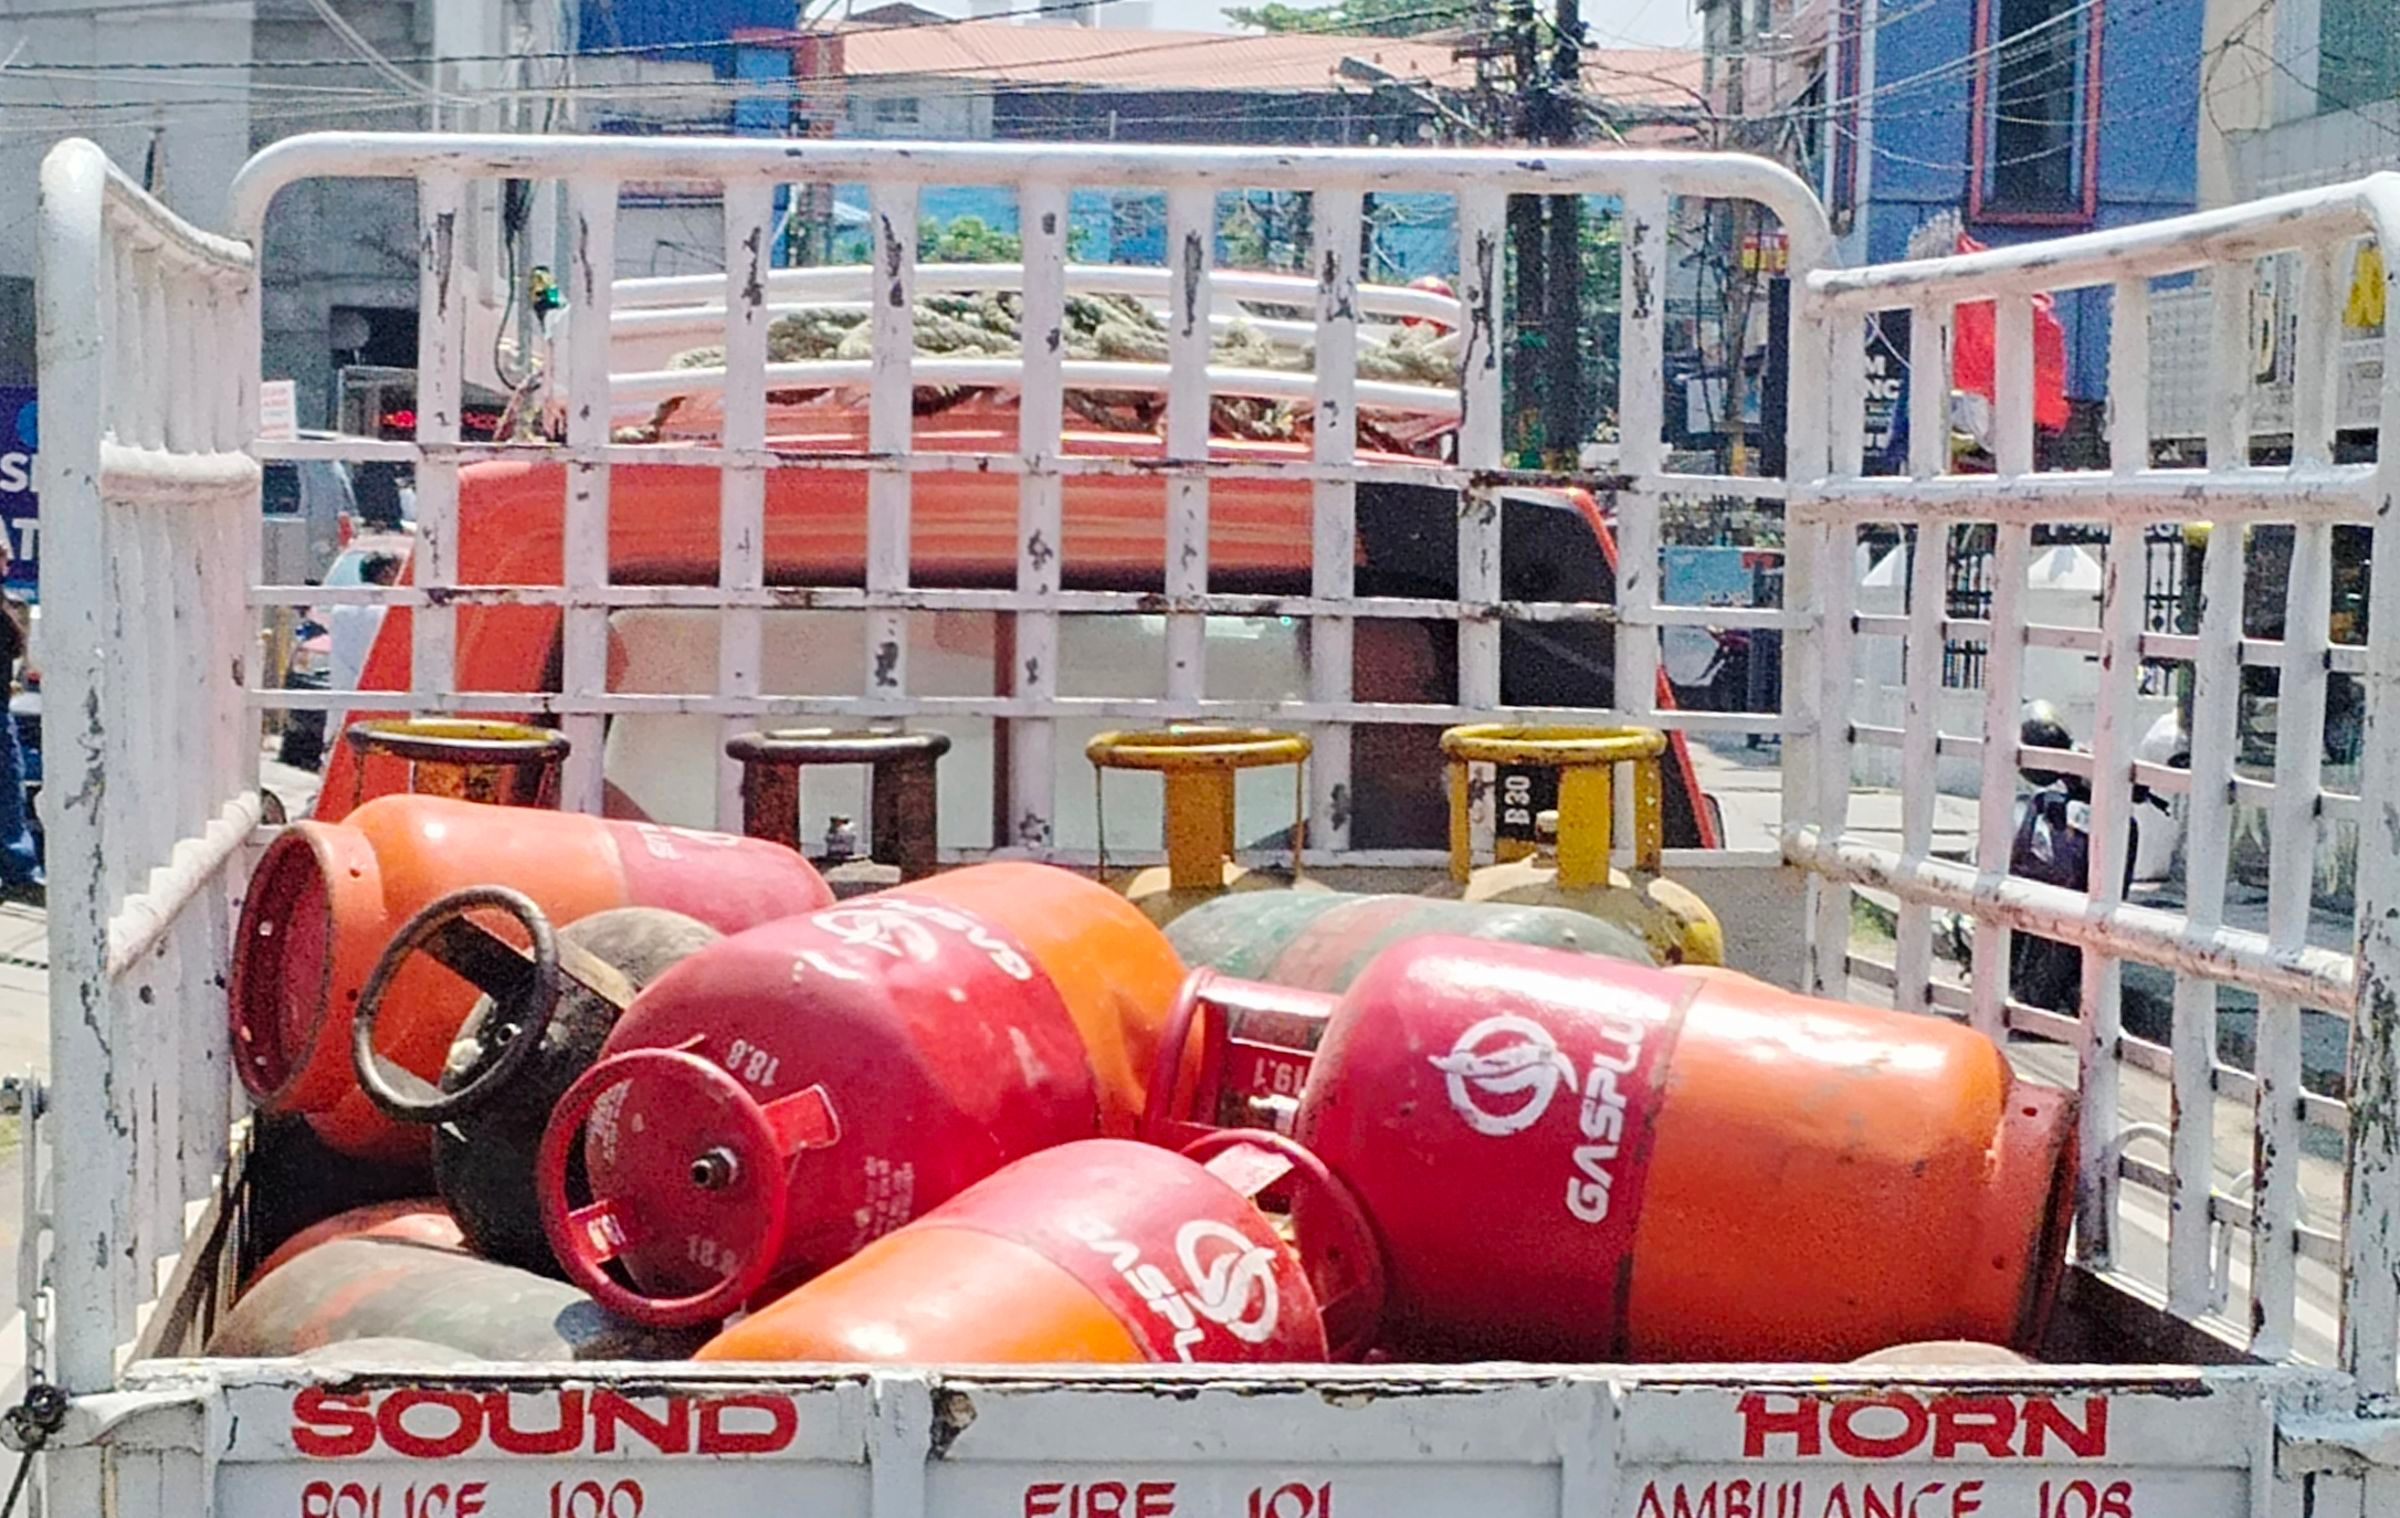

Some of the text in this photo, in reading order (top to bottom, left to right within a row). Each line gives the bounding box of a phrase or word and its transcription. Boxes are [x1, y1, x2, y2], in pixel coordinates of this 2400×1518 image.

[726, 1039, 779, 1088] 18.8
[1566, 1002, 1644, 1224] GASPLU
[291, 1386, 798, 1458] SOUND
[1736, 1390, 2109, 1458] HORN
[301, 1478, 644, 1518] POLICE 100
[1024, 1481, 1331, 1518] FIRE 101
[1634, 1478, 1984, 1518] AMBULANCE
